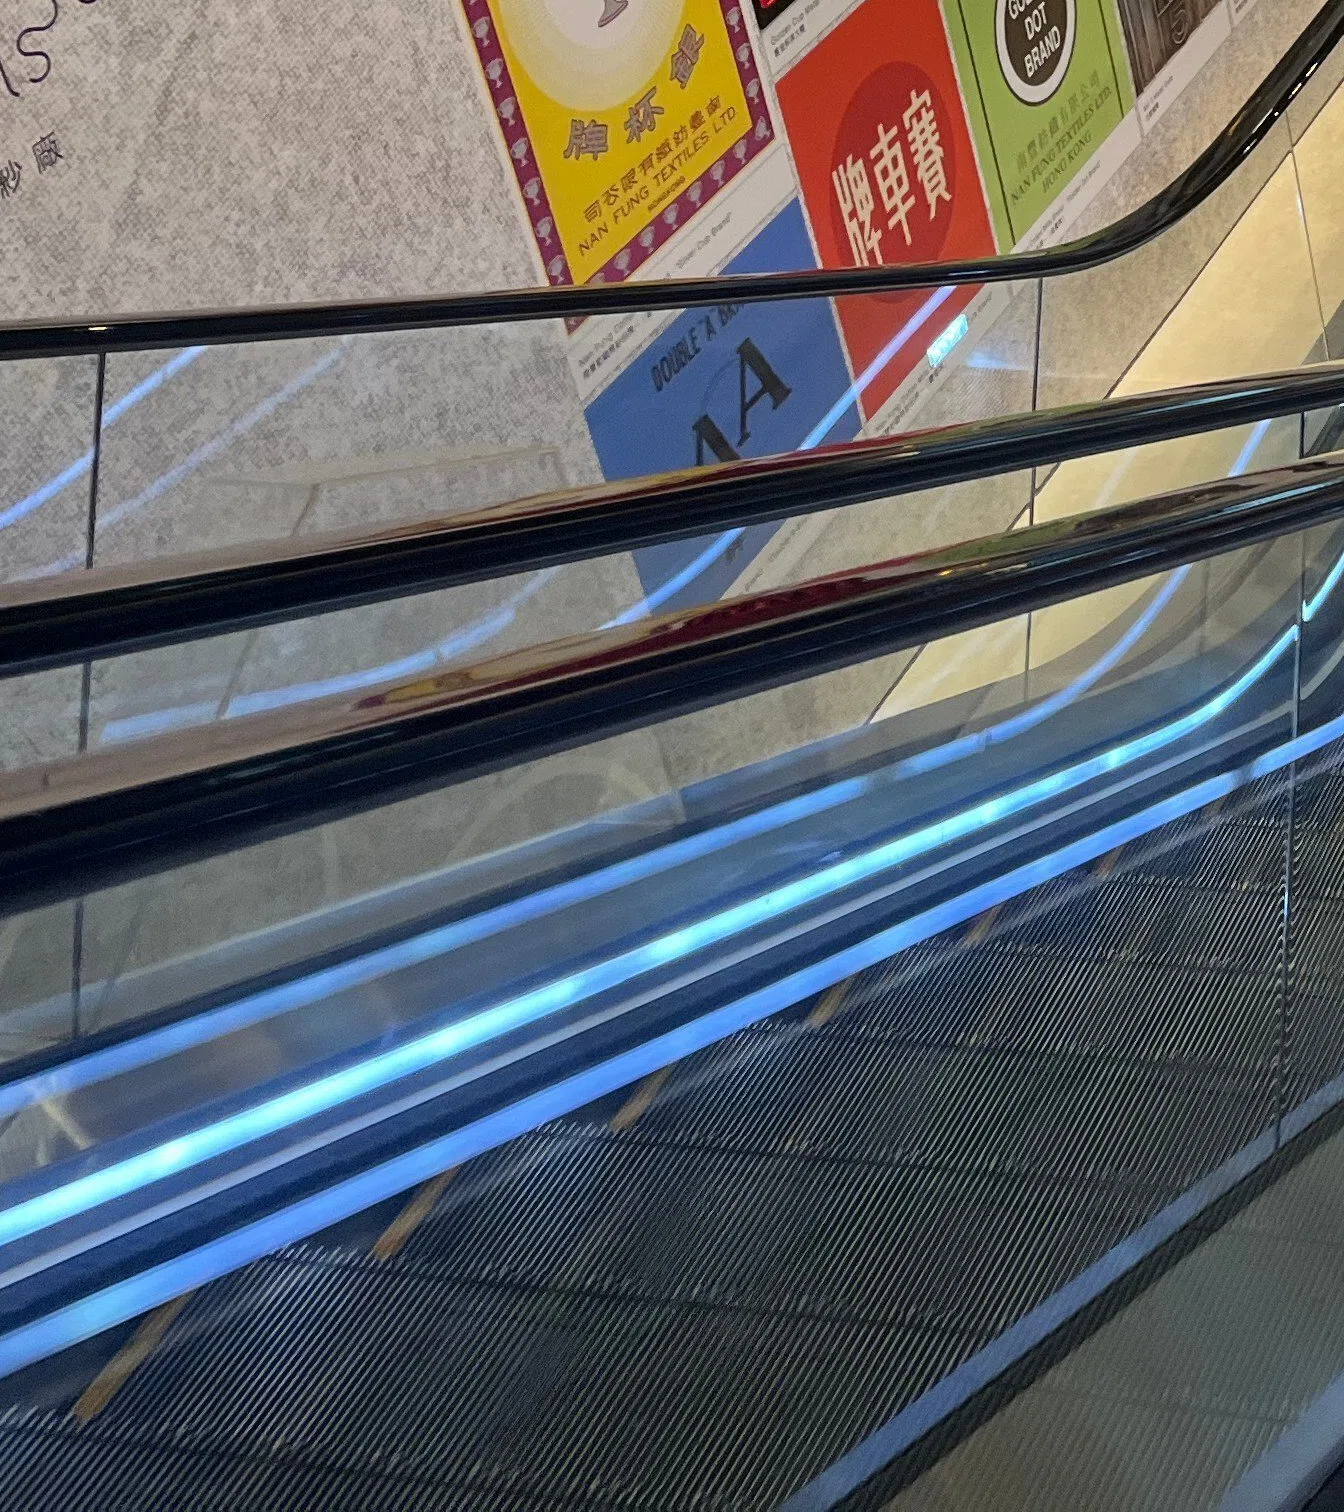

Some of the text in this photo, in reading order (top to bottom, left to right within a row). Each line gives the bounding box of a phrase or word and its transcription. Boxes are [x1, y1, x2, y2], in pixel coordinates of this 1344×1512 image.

[1023, 1, 1047, 41] DOT
[1024, 25, 1061, 78] BRAND
[578, 222, 610, 257] NAN
[612, 186, 651, 225] FUNG
[652, 131, 710, 187] TEXTILES
[651, 326, 702, 392] DOUBLE
